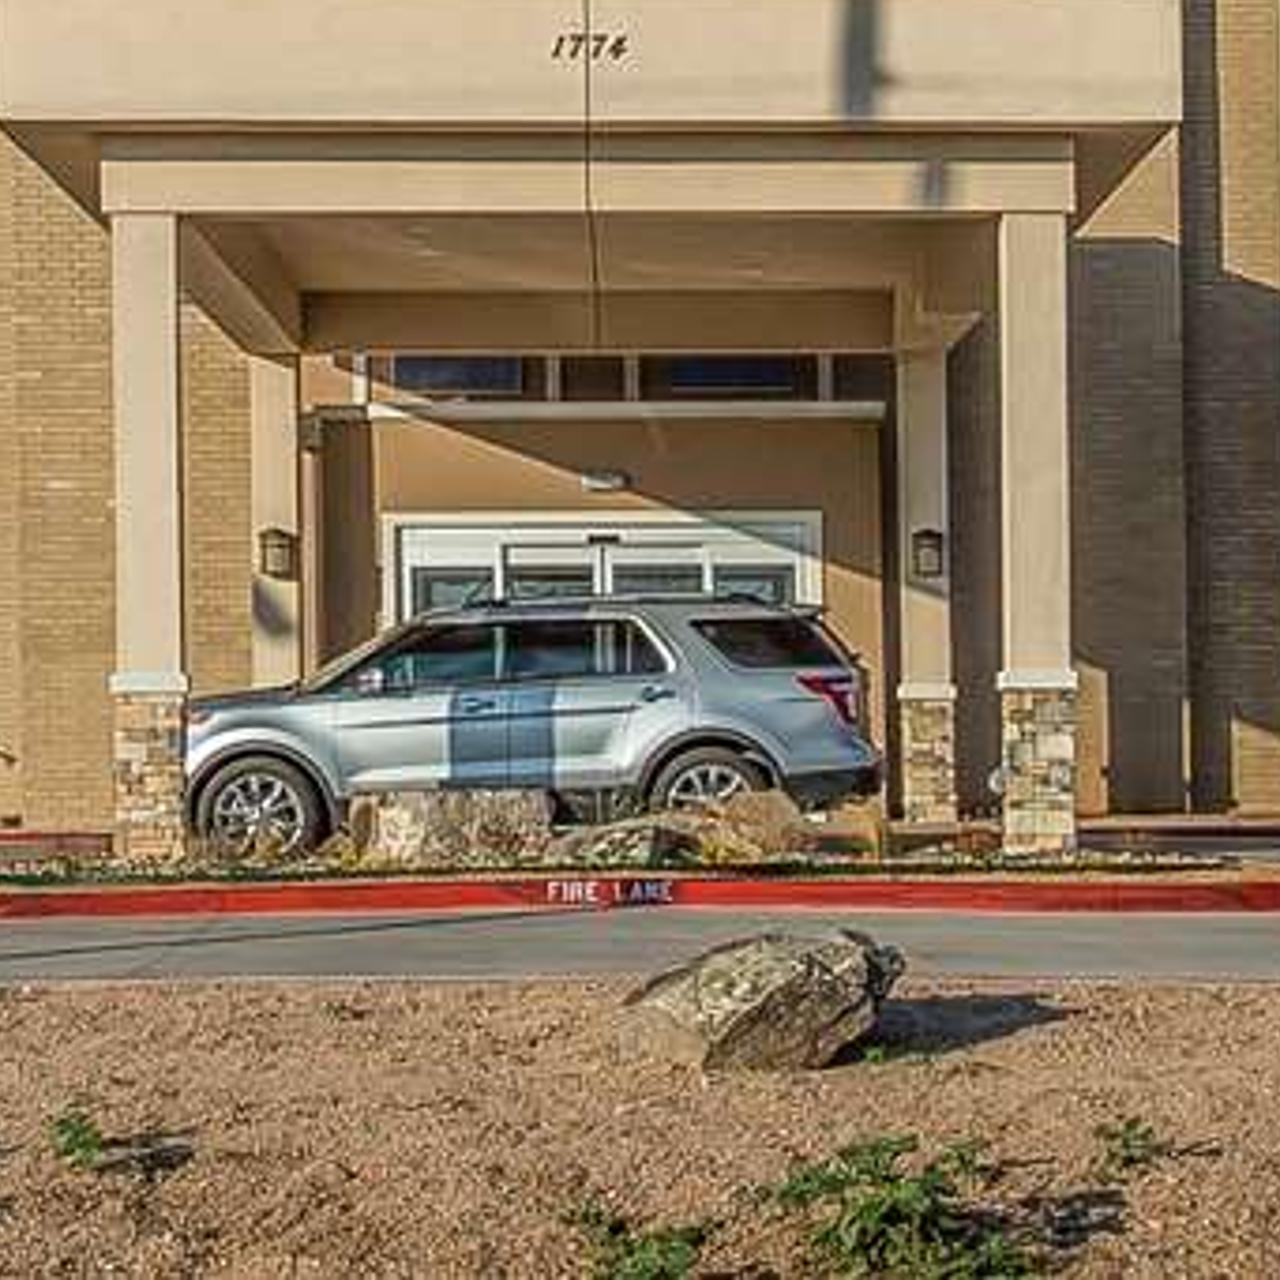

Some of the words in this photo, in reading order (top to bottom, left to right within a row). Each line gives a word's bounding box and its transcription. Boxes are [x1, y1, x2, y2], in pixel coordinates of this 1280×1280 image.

[551, 33, 628, 60] 1774
[546, 880, 599, 903] FIRE
[614, 880, 673, 903] LANE
